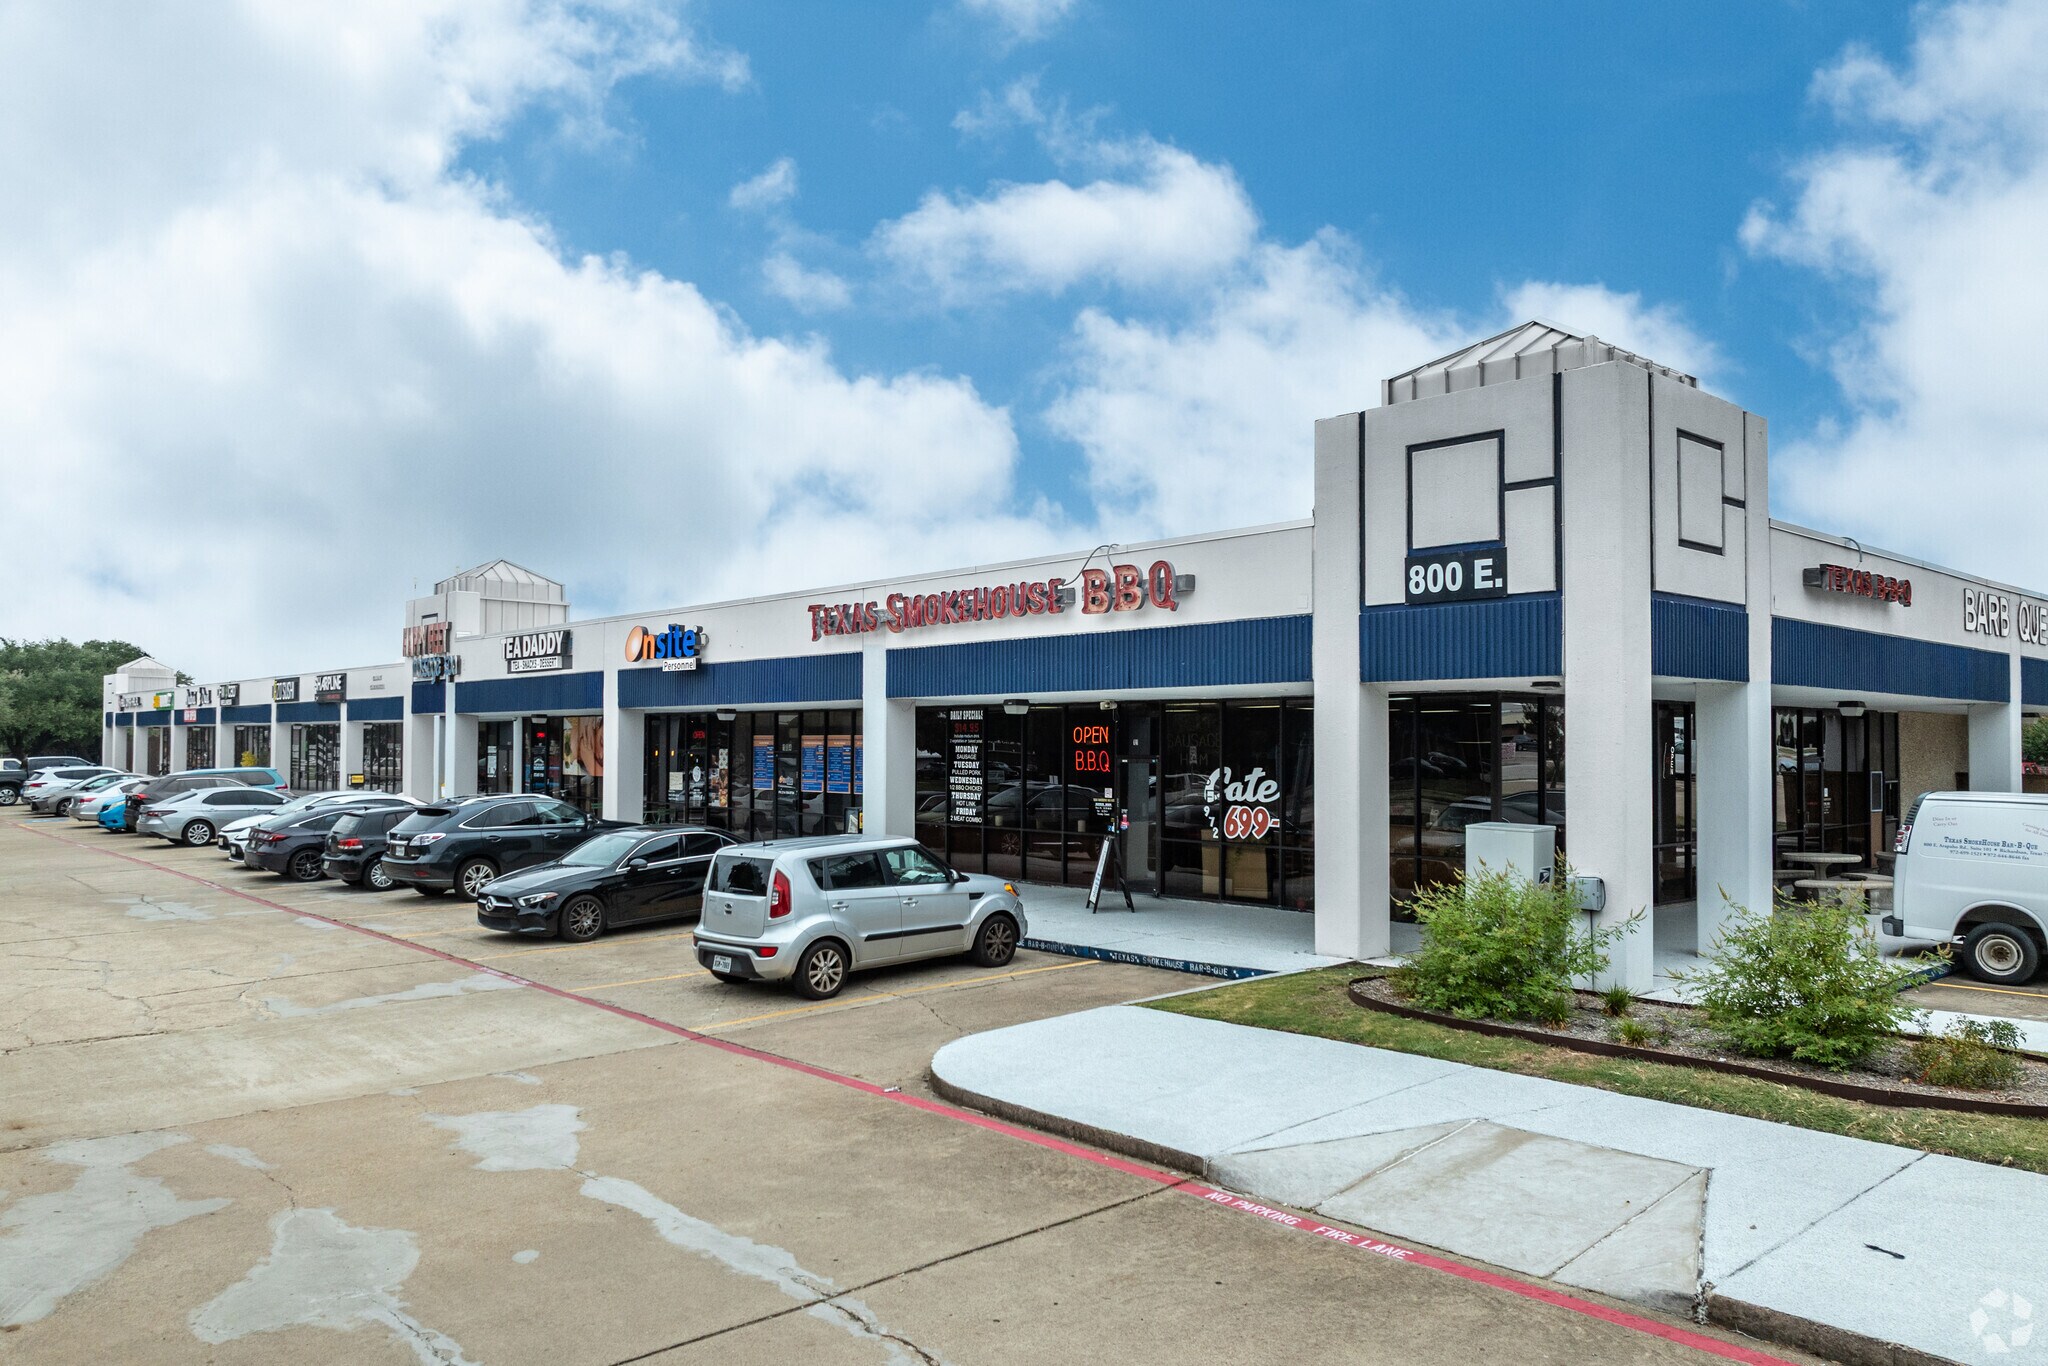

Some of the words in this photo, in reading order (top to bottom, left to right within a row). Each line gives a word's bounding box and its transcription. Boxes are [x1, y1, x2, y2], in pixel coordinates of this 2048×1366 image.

[1408, 561, 1463, 595] 800
[1474, 558, 1504, 590] E.
[1825, 565, 1874, 599] TEXAS
[1876, 574, 1912, 607] B-B-Q
[808, 601, 879, 642] TEXAS
[886, 577, 1066, 634] SMOKEHOUSE
[1082, 560, 1179, 616] BBQ
[1964, 588, 2010, 637] BARB
[2017, 600, 2048, 646] QUE
[501, 636, 522, 660] TEA
[522, 631, 564, 658] DADDY
[625, 624, 696, 663] Onsite
[663, 660, 696, 671] Personnel
[950, 710, 962, 720] DAILY
[1073, 726, 1109, 744] OPEN
[955, 745, 979, 753] MONDAY
[953, 761, 980, 769] TUESDAY
[1179, 752, 1209, 767] HM
[949, 776, 983, 785] WEDNESDAY
[951, 791, 982, 800] THURSDAY
[955, 807, 977, 816] FRIDAY
[1204, 1190, 1232, 1204] NO
[1232, 1198, 1302, 1227] PARKING
[1312, 1226, 1360, 1245] FIRE
[1357, 1239, 1414, 1261] LANE
